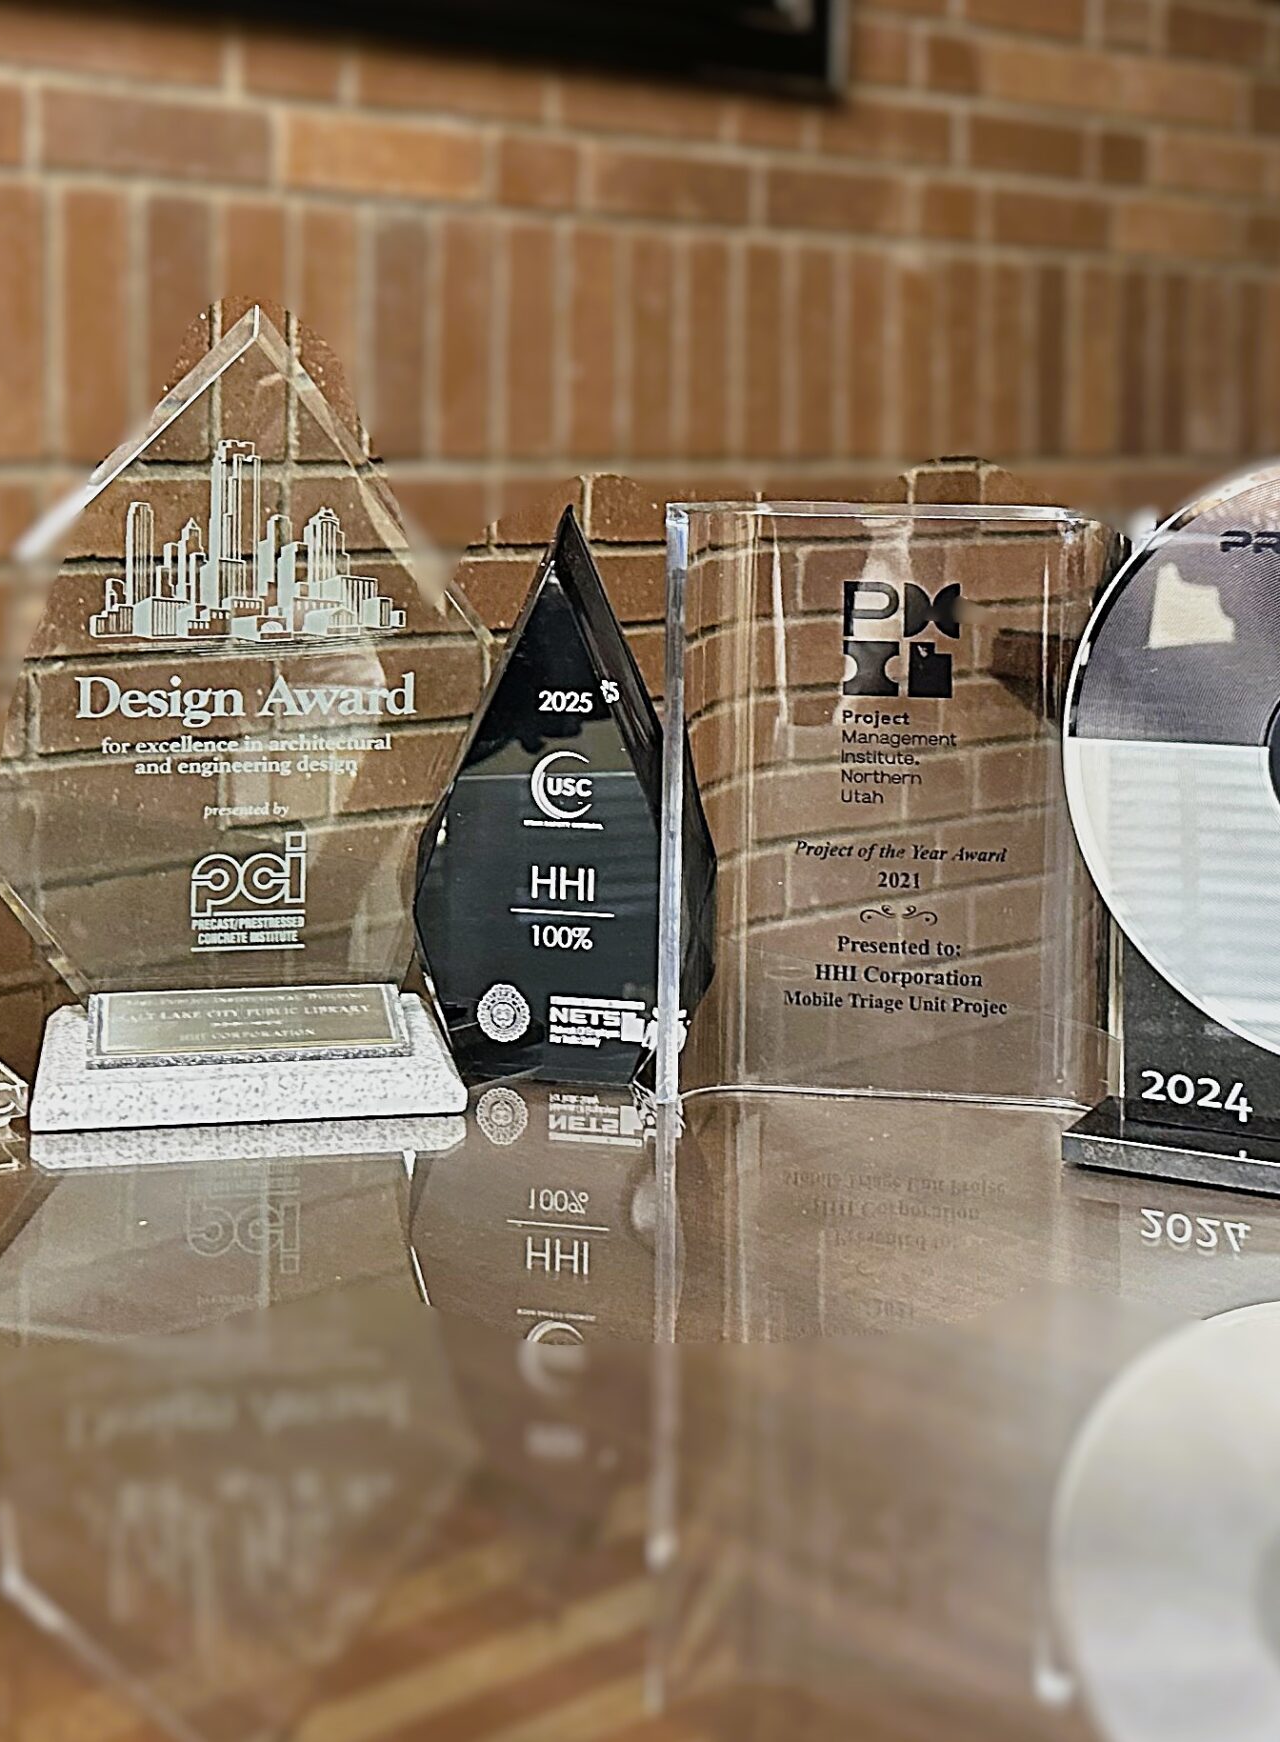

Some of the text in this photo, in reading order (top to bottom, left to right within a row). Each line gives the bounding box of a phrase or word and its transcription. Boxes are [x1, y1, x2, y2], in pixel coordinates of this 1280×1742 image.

[75, 672, 417, 729] Design Award
[538, 690, 594, 713] 2025
[842, 710, 910, 729] Project
[102, 733, 392, 755] for excellence in architectural
[841, 729, 957, 747] Management
[135, 757, 358, 778] and engineering design
[841, 749, 920, 765] Institute.
[546, 776, 593, 797] USC
[841, 768, 922, 785] Northern
[841, 788, 884, 804] Utah
[204, 802, 290, 819] presented by
[795, 840, 1008, 863] Project of the Year Award
[191, 831, 307, 917] pci
[530, 865, 595, 902] HHI
[878, 871, 921, 888] 2021
[191, 916, 305, 930] PRECAST/PRESTRESSED
[198, 930, 299, 945] CONCRETE INSTITUTE
[532, 924, 594, 950] 100%
[837, 935, 961, 957] Presented to:
[815, 964, 983, 988] HHI Corporation
[161, 1009, 201, 1020] LAKE
[247, 1006, 297, 1017] PUBLIC
[304, 1003, 371, 1015] LIBRARY
[783, 990, 1008, 1018] Mobile Triage Unit Projec
[549, 1006, 621, 1026] NETS
[211, 1028, 316, 1040] CORPORATION
[1141, 1070, 1253, 1123] 2024
